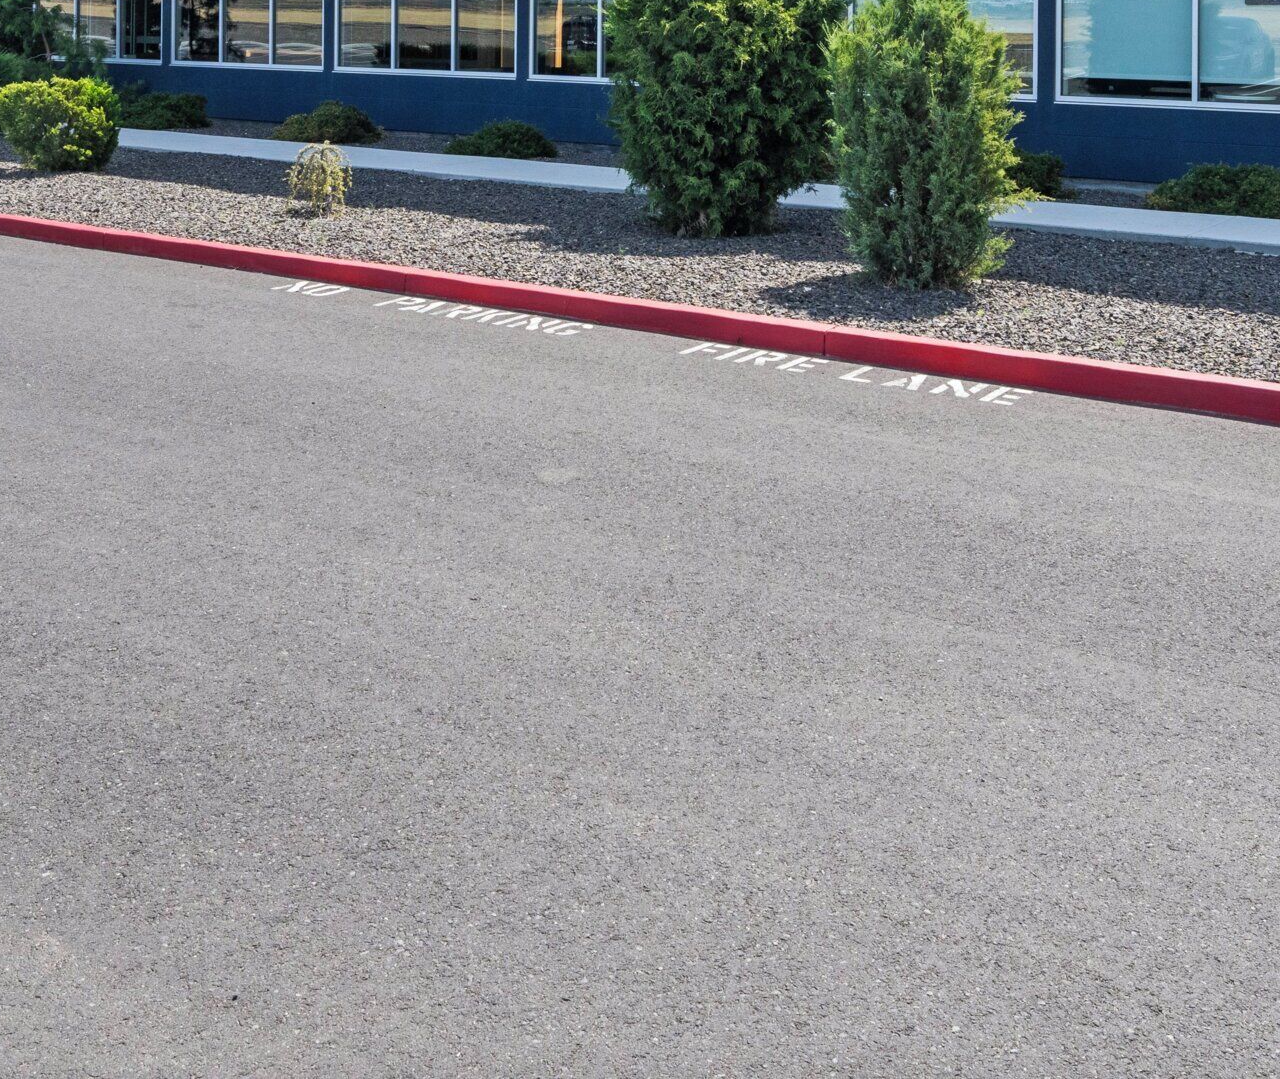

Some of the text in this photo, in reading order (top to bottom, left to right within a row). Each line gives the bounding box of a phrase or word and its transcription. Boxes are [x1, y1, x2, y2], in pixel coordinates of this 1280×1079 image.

[270, 281, 594, 336] NO PARKING
[678, 341, 1037, 406] FIRE LANE
